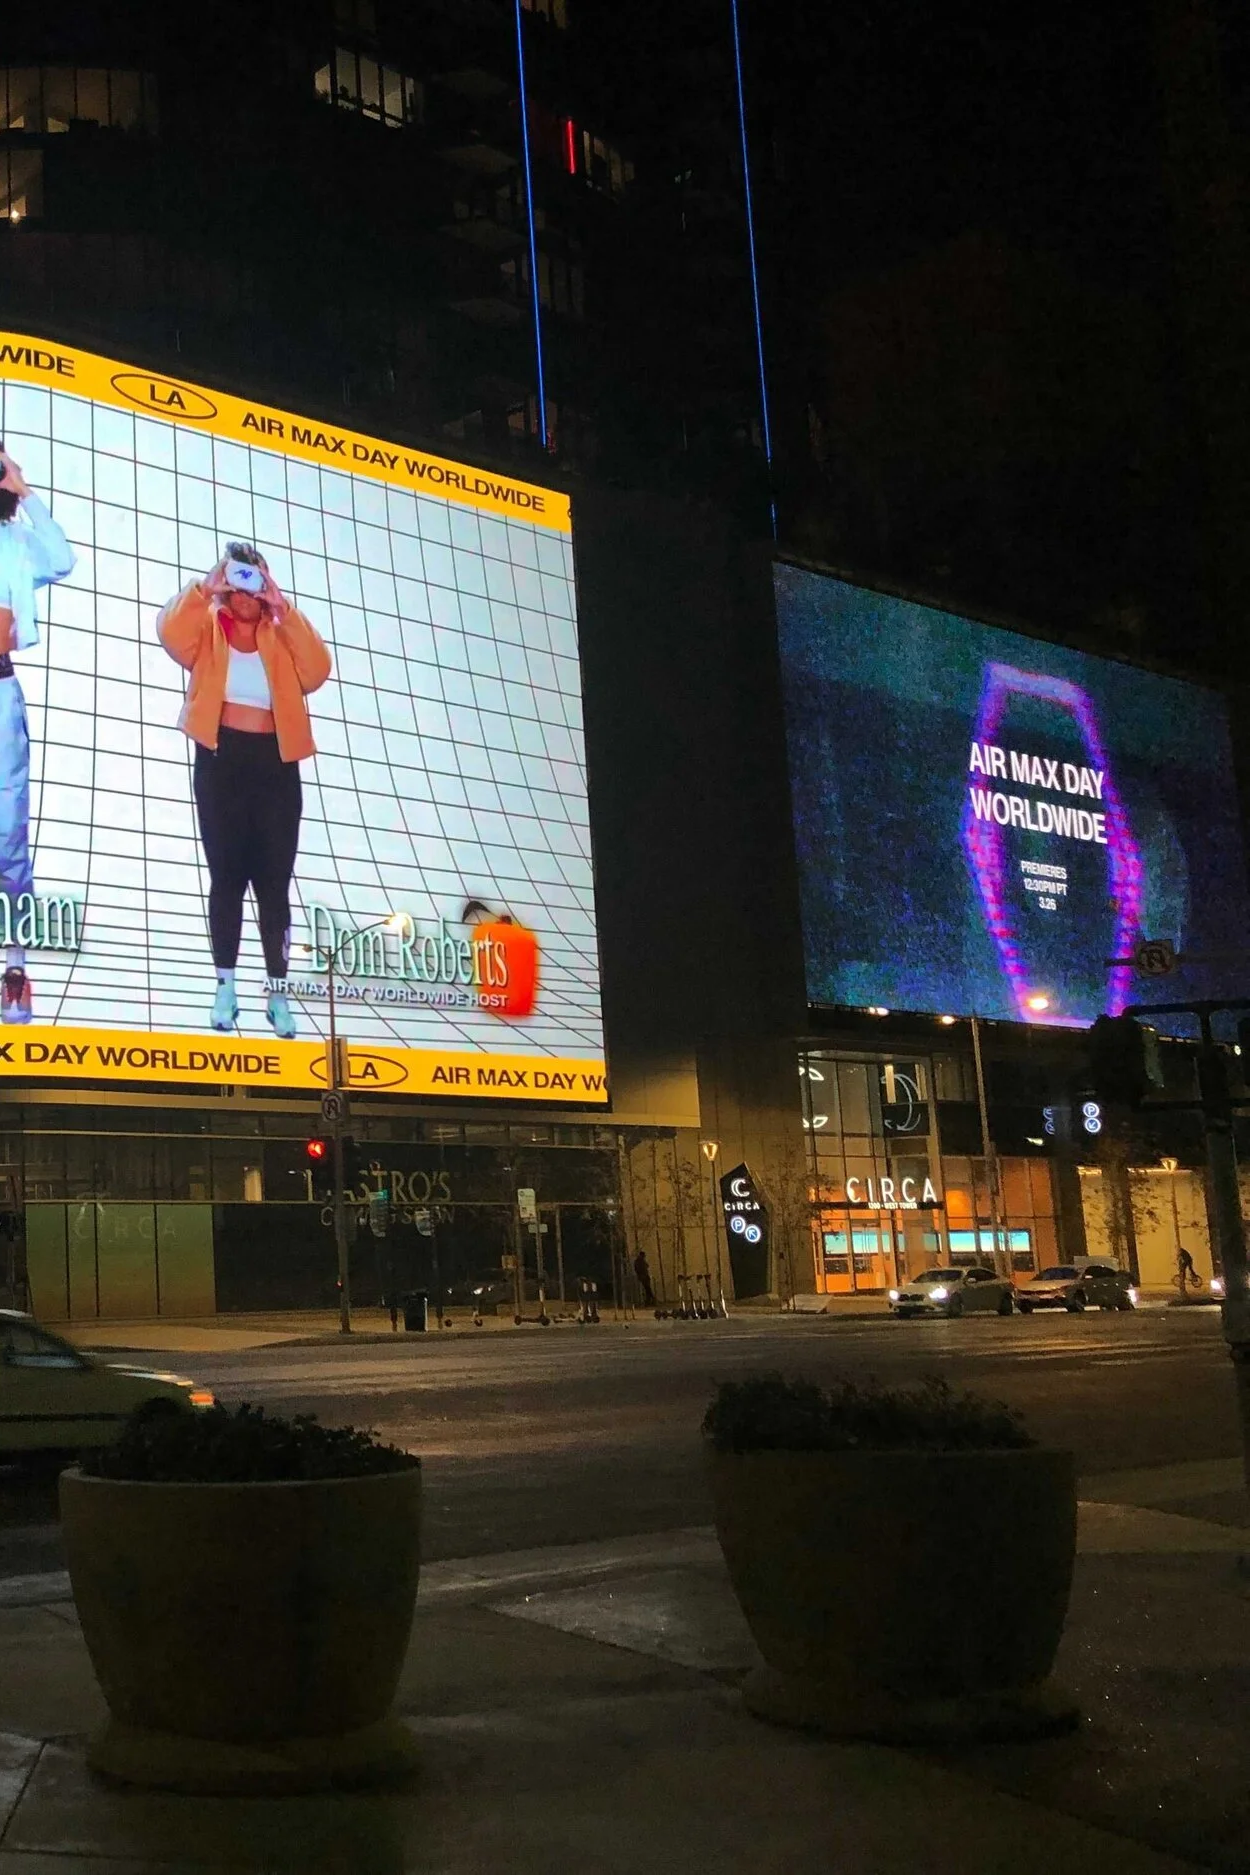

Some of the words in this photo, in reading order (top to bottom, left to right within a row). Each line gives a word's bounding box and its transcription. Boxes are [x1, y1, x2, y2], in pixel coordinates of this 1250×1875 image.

[149, 383, 187, 411] LA
[241, 412, 284, 438] AIR
[291, 424, 347, 456] MAX
[352, 443, 400, 471] DAY
[404, 458, 545, 513] WORLDWIDE
[969, 742, 1007, 779] AIR
[1010, 751, 1061, 791] MAX
[1062, 762, 1104, 799] DAY
[969, 787, 1108, 844] WORLDWIDE
[1020, 860, 1067, 880] PREMIERES
[1023, 878, 1056, 894] 12:30PM
[1057, 883, 1068, 896] PT
[1039, 896, 1057, 911] 3.26
[308, 903, 386, 978] Dom
[396, 912, 509, 987] Roberts
[263, 977, 292, 994] AIR
[295, 981, 330, 996] MAX
[335, 985, 366, 1000] DAY
[371, 987, 471, 1007] WORLDWIDE
[471, 992, 509, 1008] HOST
[24, 1044, 91, 1066] DAY
[97, 1046, 281, 1075] WORLDWIDE
[348, 1060, 380, 1080] LA
[431, 1065, 471, 1085] AIR
[477, 1068, 529, 1088] MAX
[534, 1071, 577, 1090] DAY
[581, 1074, 607, 1092] W
[846, 1176, 938, 1203] CIRCA
[724, 1201, 760, 1211] CIRCA
